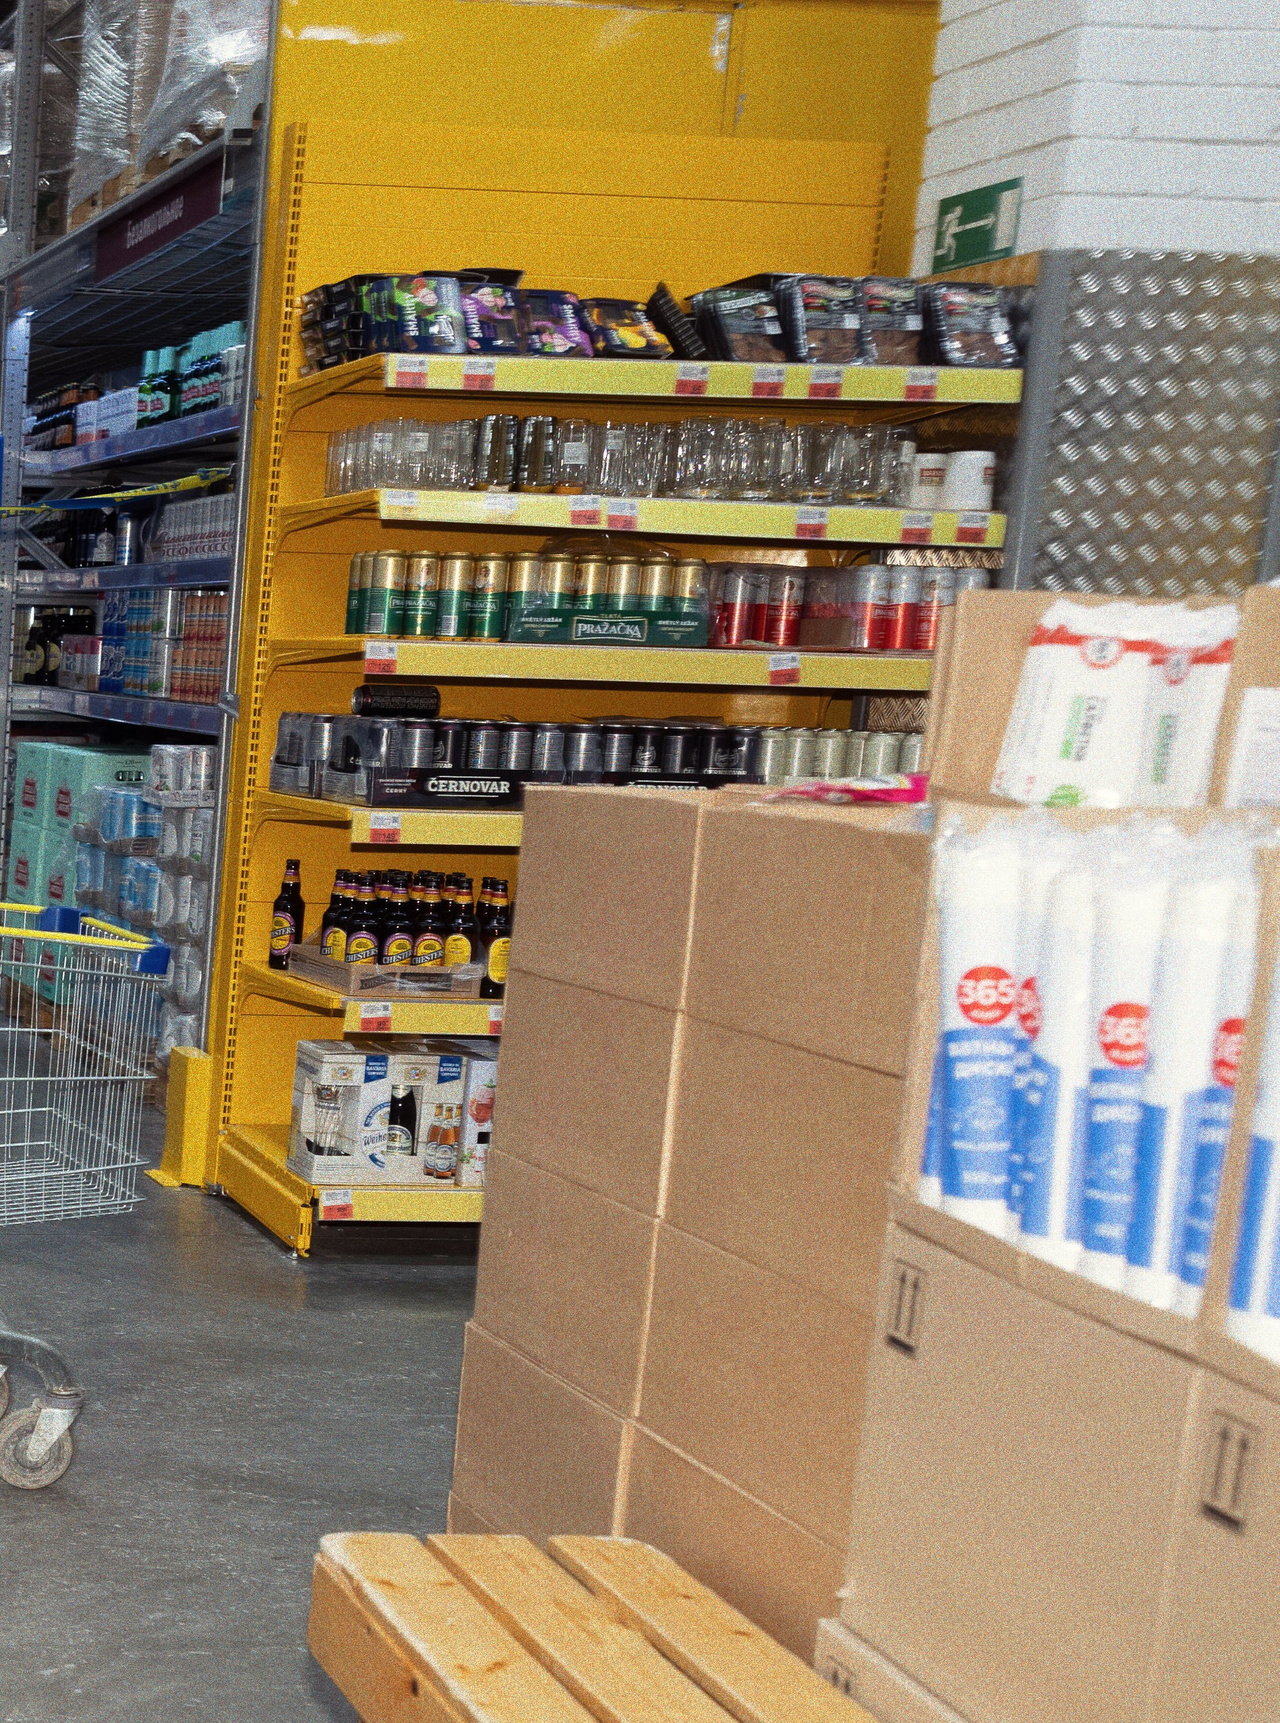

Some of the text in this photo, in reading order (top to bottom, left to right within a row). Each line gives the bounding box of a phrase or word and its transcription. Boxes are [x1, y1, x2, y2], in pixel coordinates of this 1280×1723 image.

[577, 620, 643, 639] PRAŽAČKA
[428, 777, 511, 793] ČERNOVAR
[958, 978, 1015, 1005] 365
